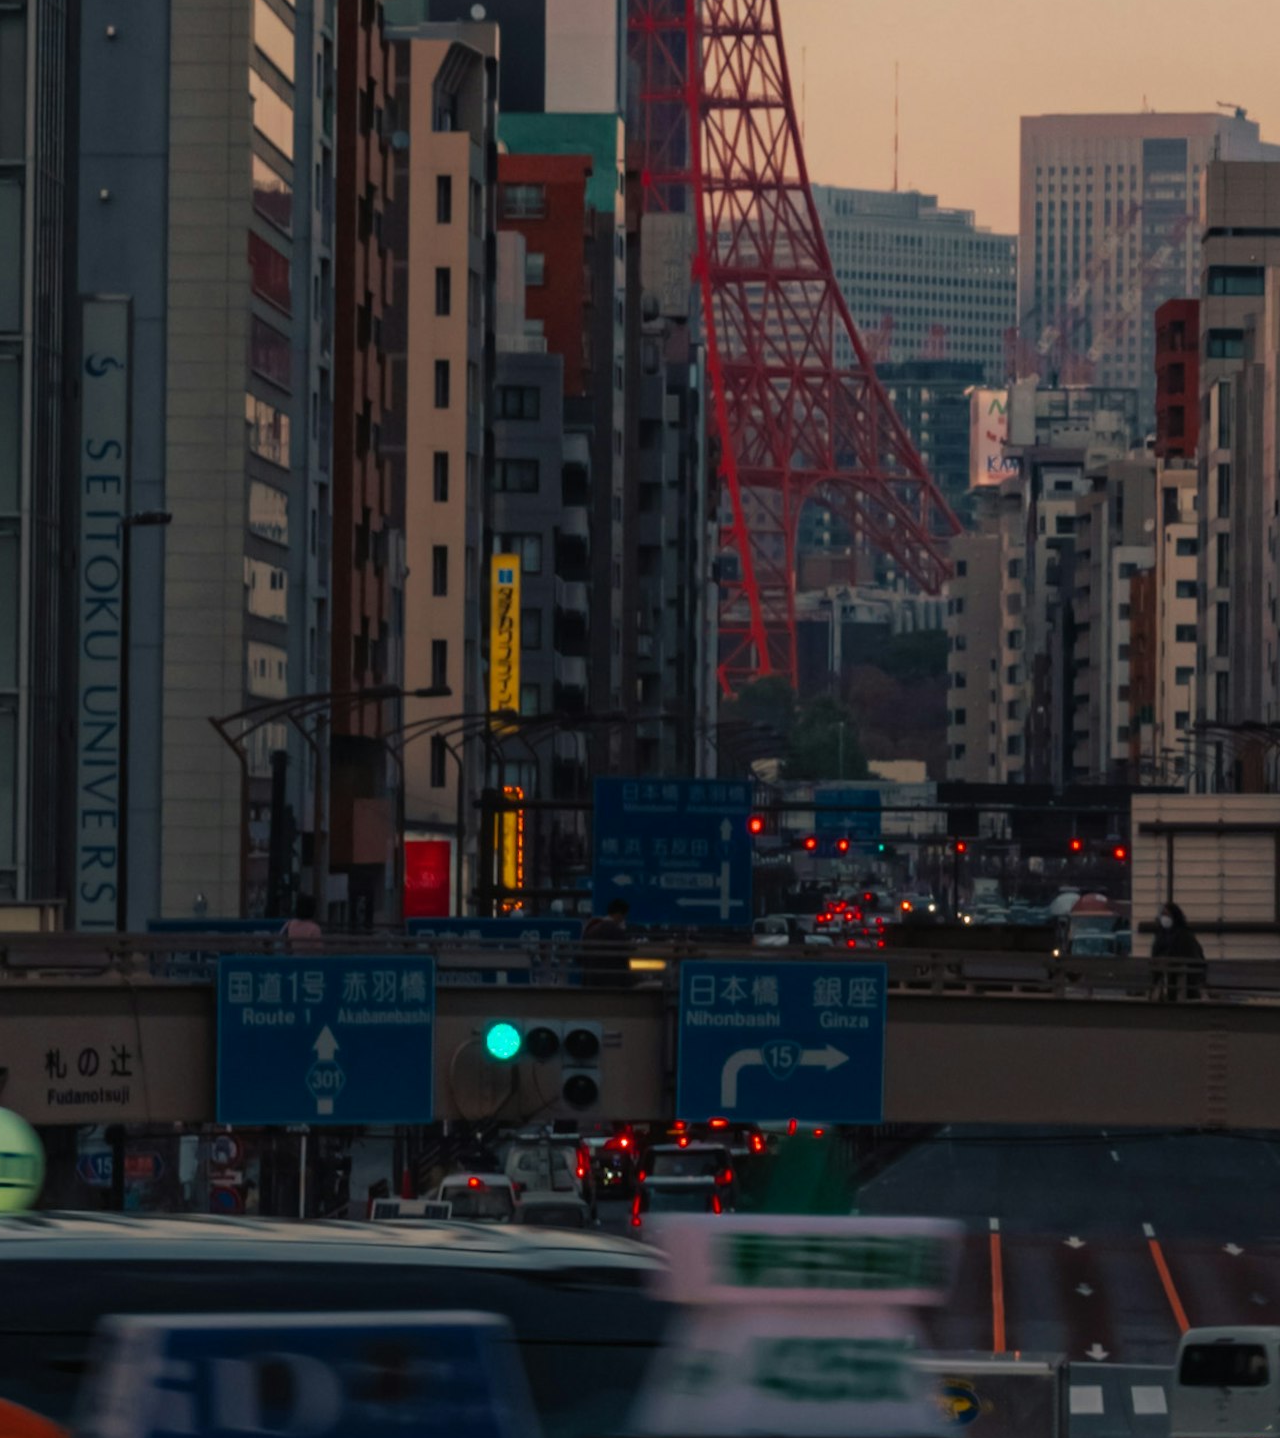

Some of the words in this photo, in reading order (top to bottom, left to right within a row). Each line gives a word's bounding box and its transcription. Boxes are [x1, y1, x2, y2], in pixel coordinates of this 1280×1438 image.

[84, 437, 121, 661] SEITOKU
[227, 970, 326, 1004] 国道1号
[342, 969, 427, 1003] 赤羽橋
[689, 974, 780, 1006] 日本橋
[811, 976, 879, 1008] 銀座
[242, 1007, 296, 1025] Route
[819, 1010, 869, 1029] Ginza
[770, 1045, 793, 1068] 15
[312, 1069, 342, 1089] 301
